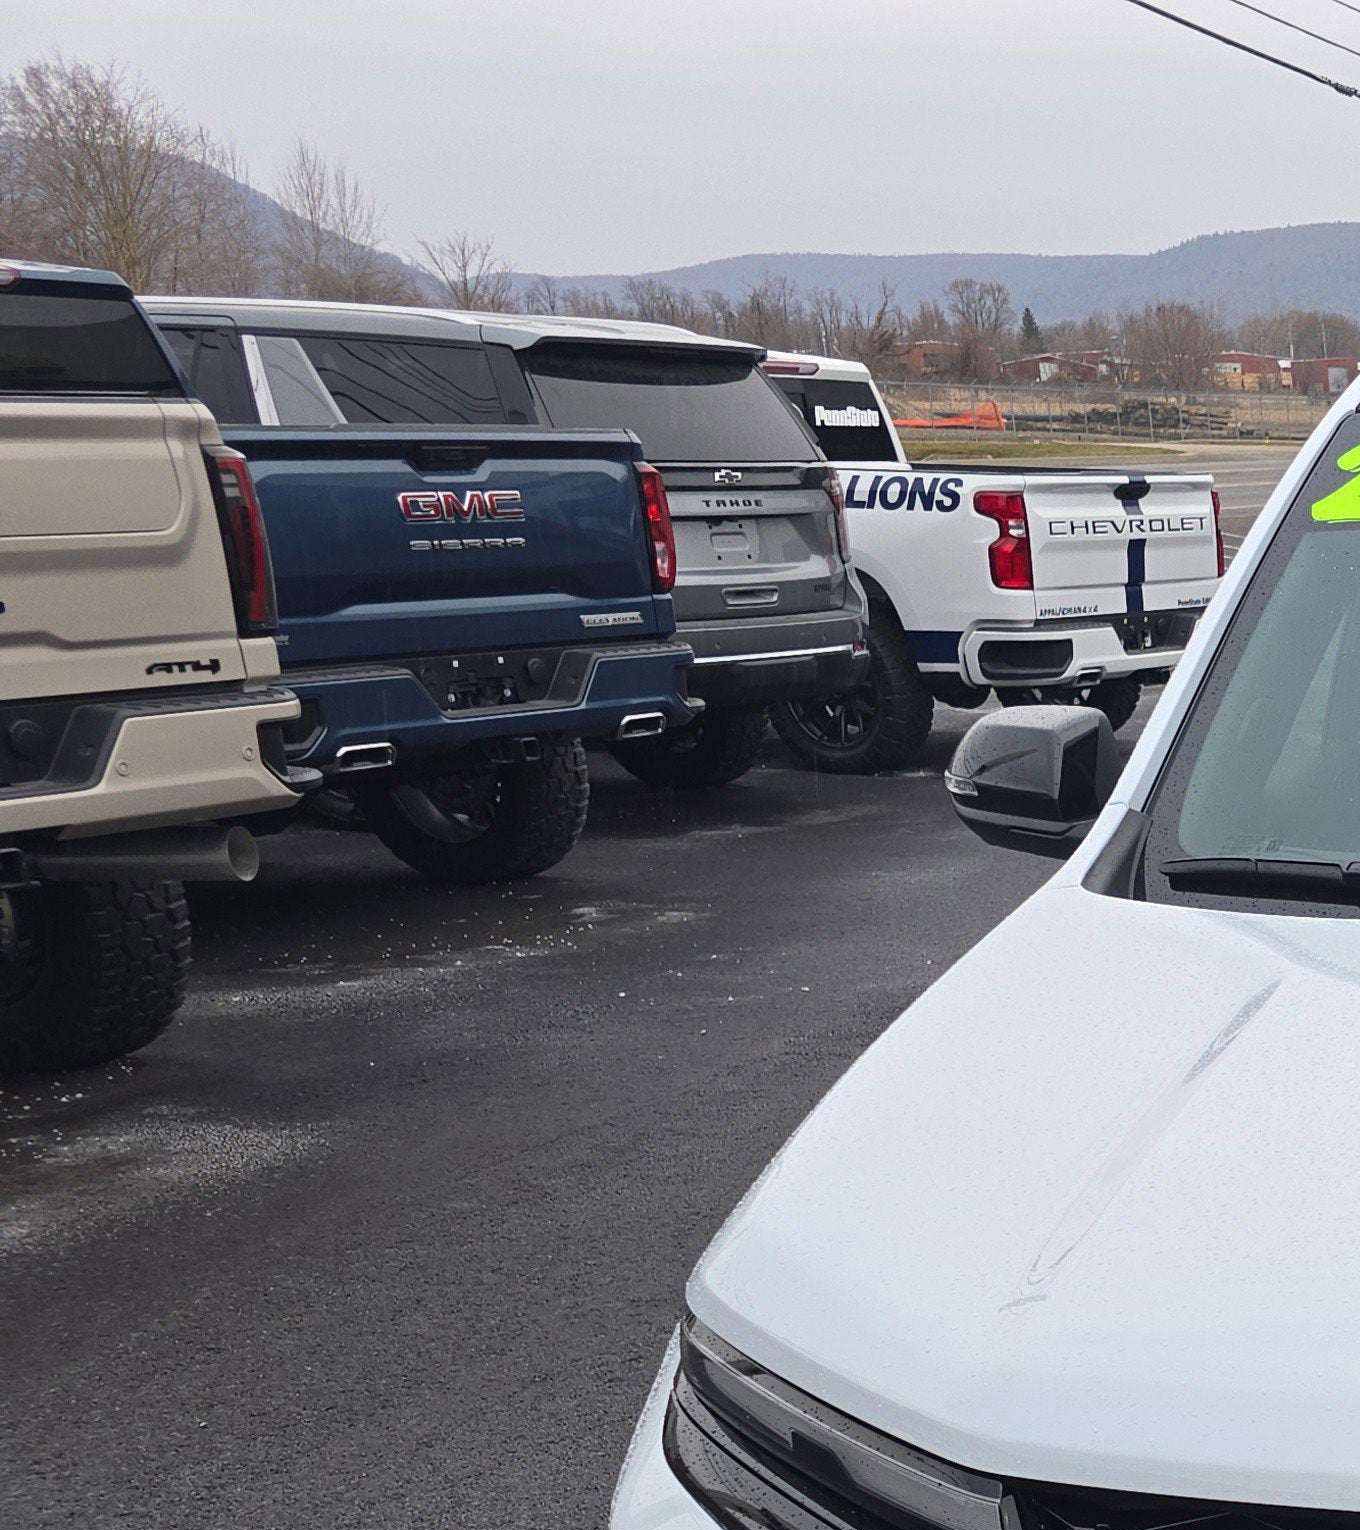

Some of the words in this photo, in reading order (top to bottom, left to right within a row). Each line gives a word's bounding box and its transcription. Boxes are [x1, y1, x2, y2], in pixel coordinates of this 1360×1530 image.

[702, 498, 764, 508] TAHOE
[845, 474, 964, 513] LIONS
[397, 490, 526, 524] GMC
[1048, 516, 1207, 537] CHEVROLET
[409, 537, 526, 551] SIERRA
[145, 658, 221, 675] AT4
